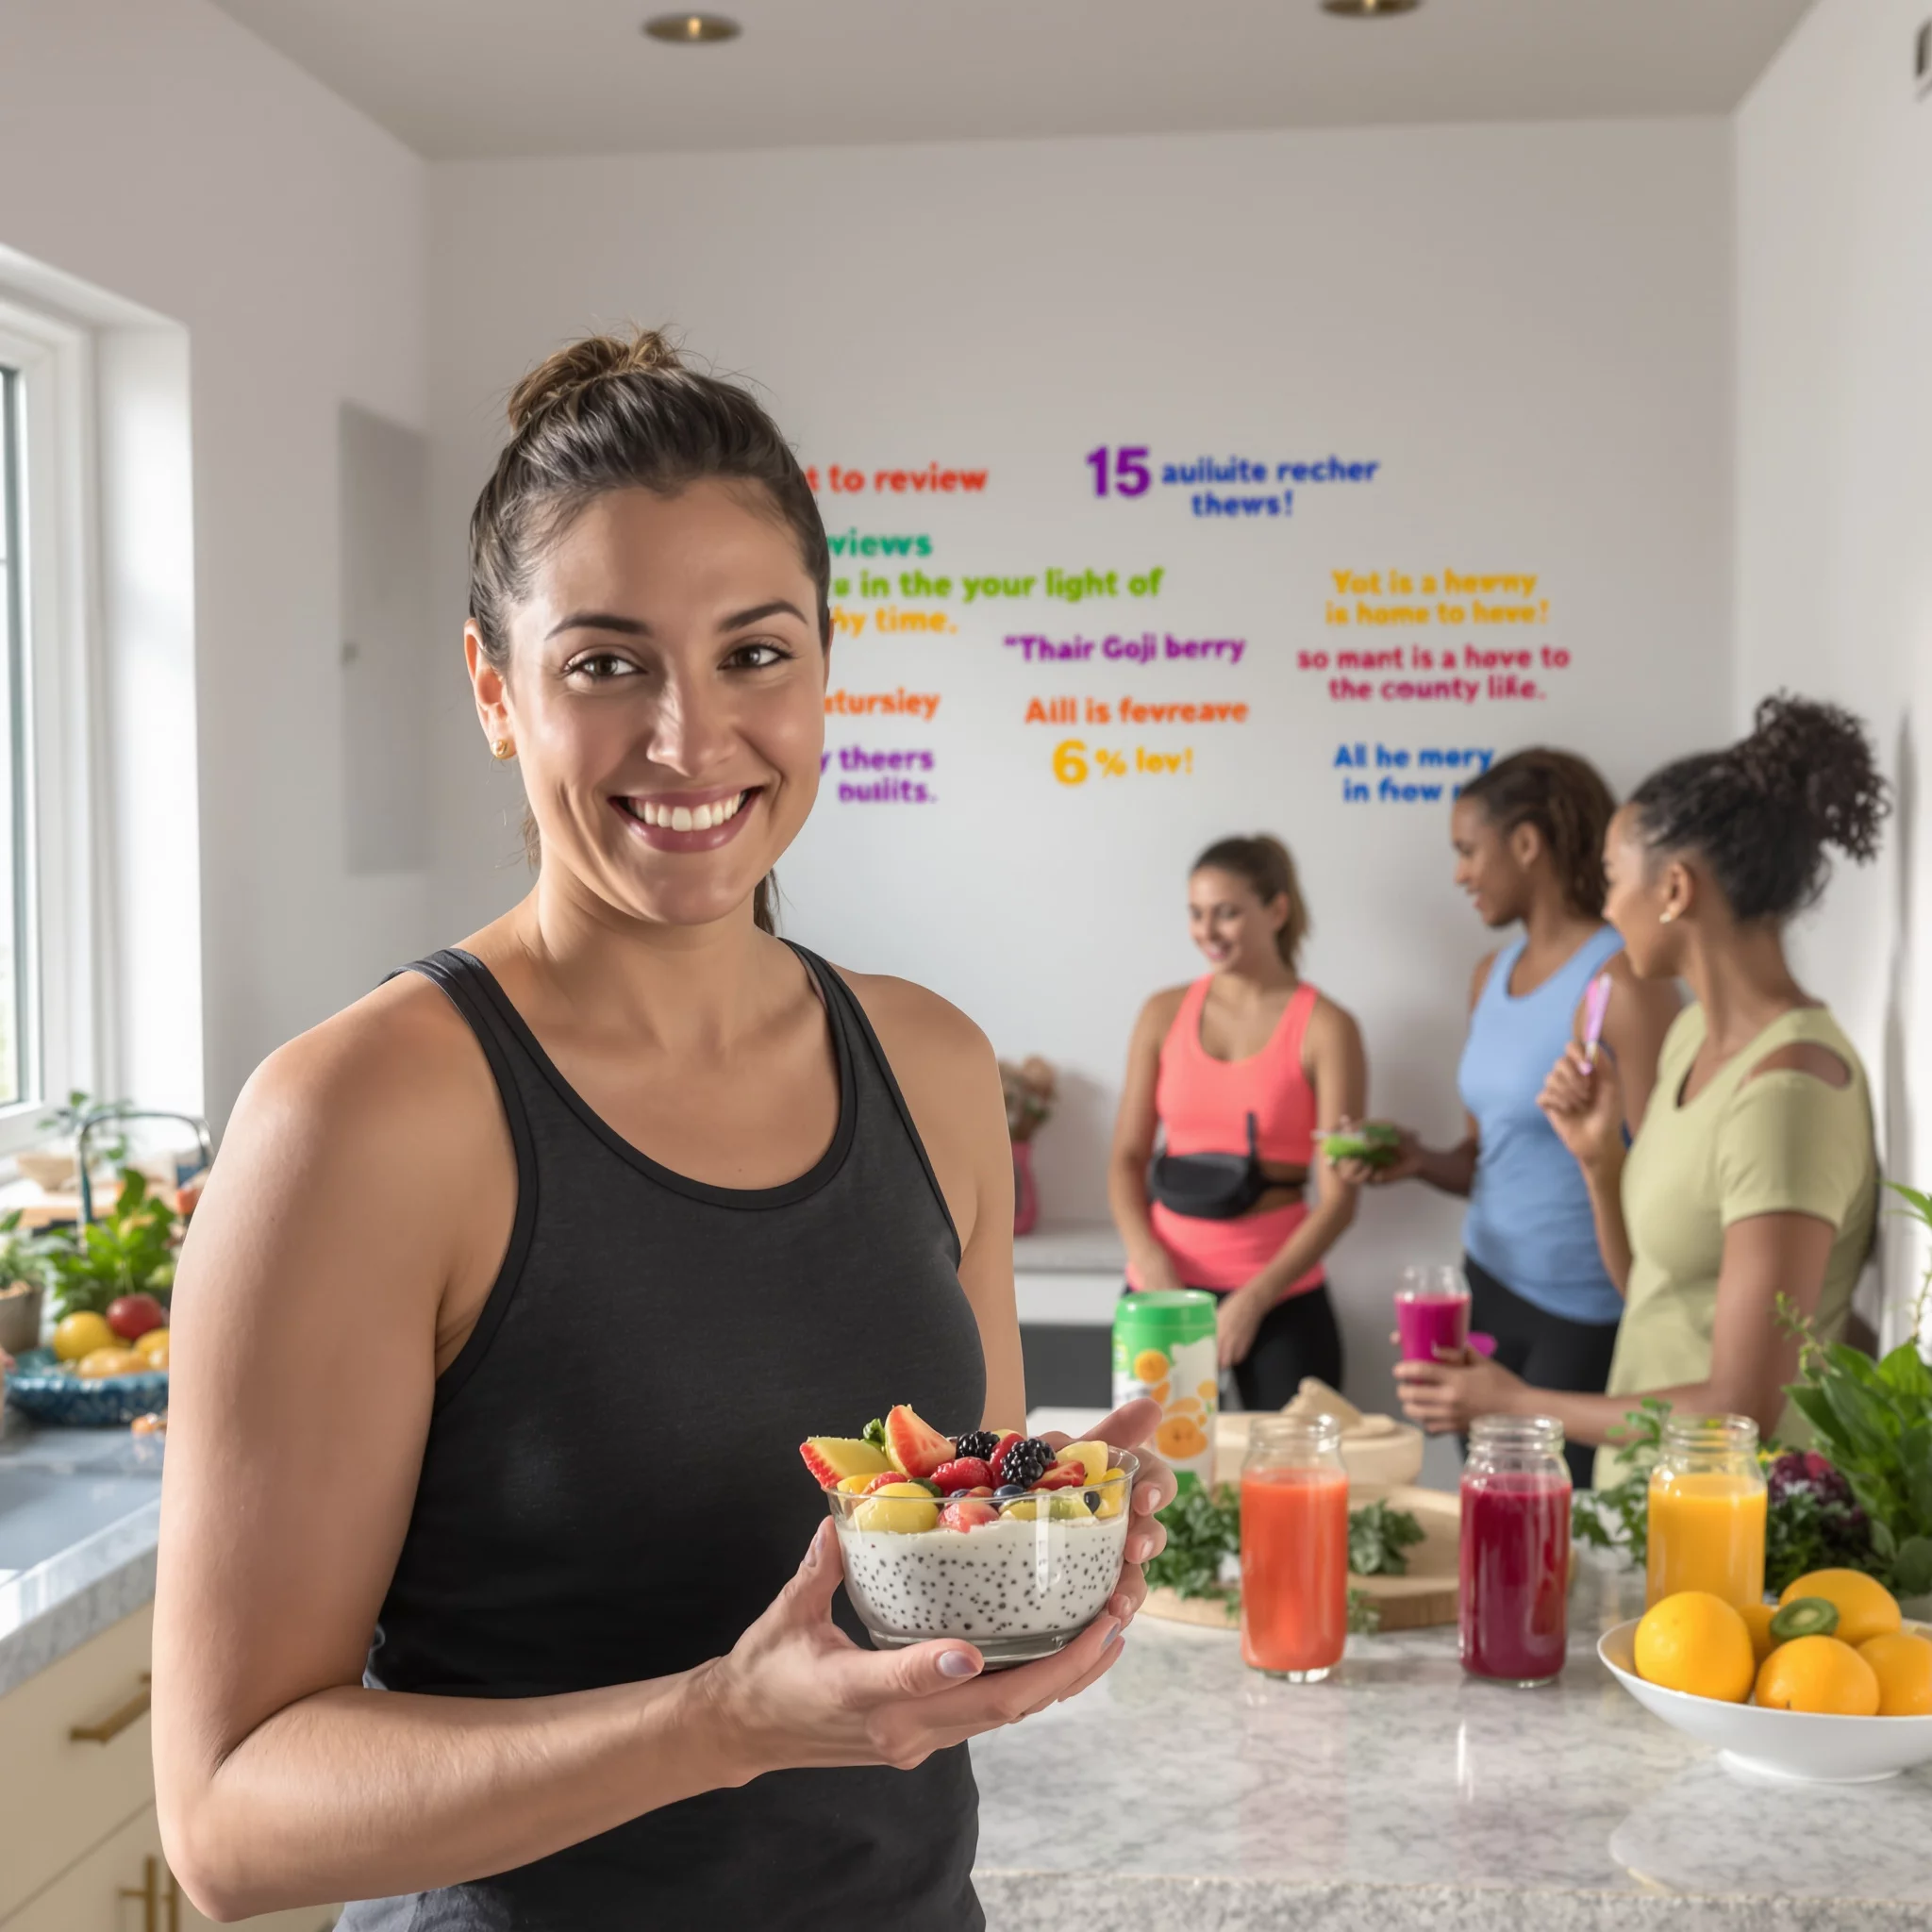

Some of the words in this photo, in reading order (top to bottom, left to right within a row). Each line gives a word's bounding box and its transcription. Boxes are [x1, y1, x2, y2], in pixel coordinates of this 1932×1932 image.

[828, 464, 866, 493] to
[874, 461, 988, 493] review
[1085, 445, 1152, 498] 15
[1276, 456, 1379, 482] recher
[860, 569, 891, 598] in
[898, 569, 953, 598] the
[961, 575, 1036, 604] your
[1044, 568, 1120, 604] light
[1126, 565, 1166, 598] of
[874, 605, 958, 635] time.
[1436, 600, 1467, 625] to
[1102, 633, 1158, 665] Goji
[1164, 633, 1246, 665] berry
[1297, 649, 1330, 671] so
[1411, 645, 1434, 670] is
[1441, 651, 1457, 670] a
[1540, 644, 1572, 670] to
[1328, 676, 1373, 702] the
[1085, 696, 1112, 724] is
[1052, 738, 1090, 788] 6
[1342, 777, 1371, 803] in
